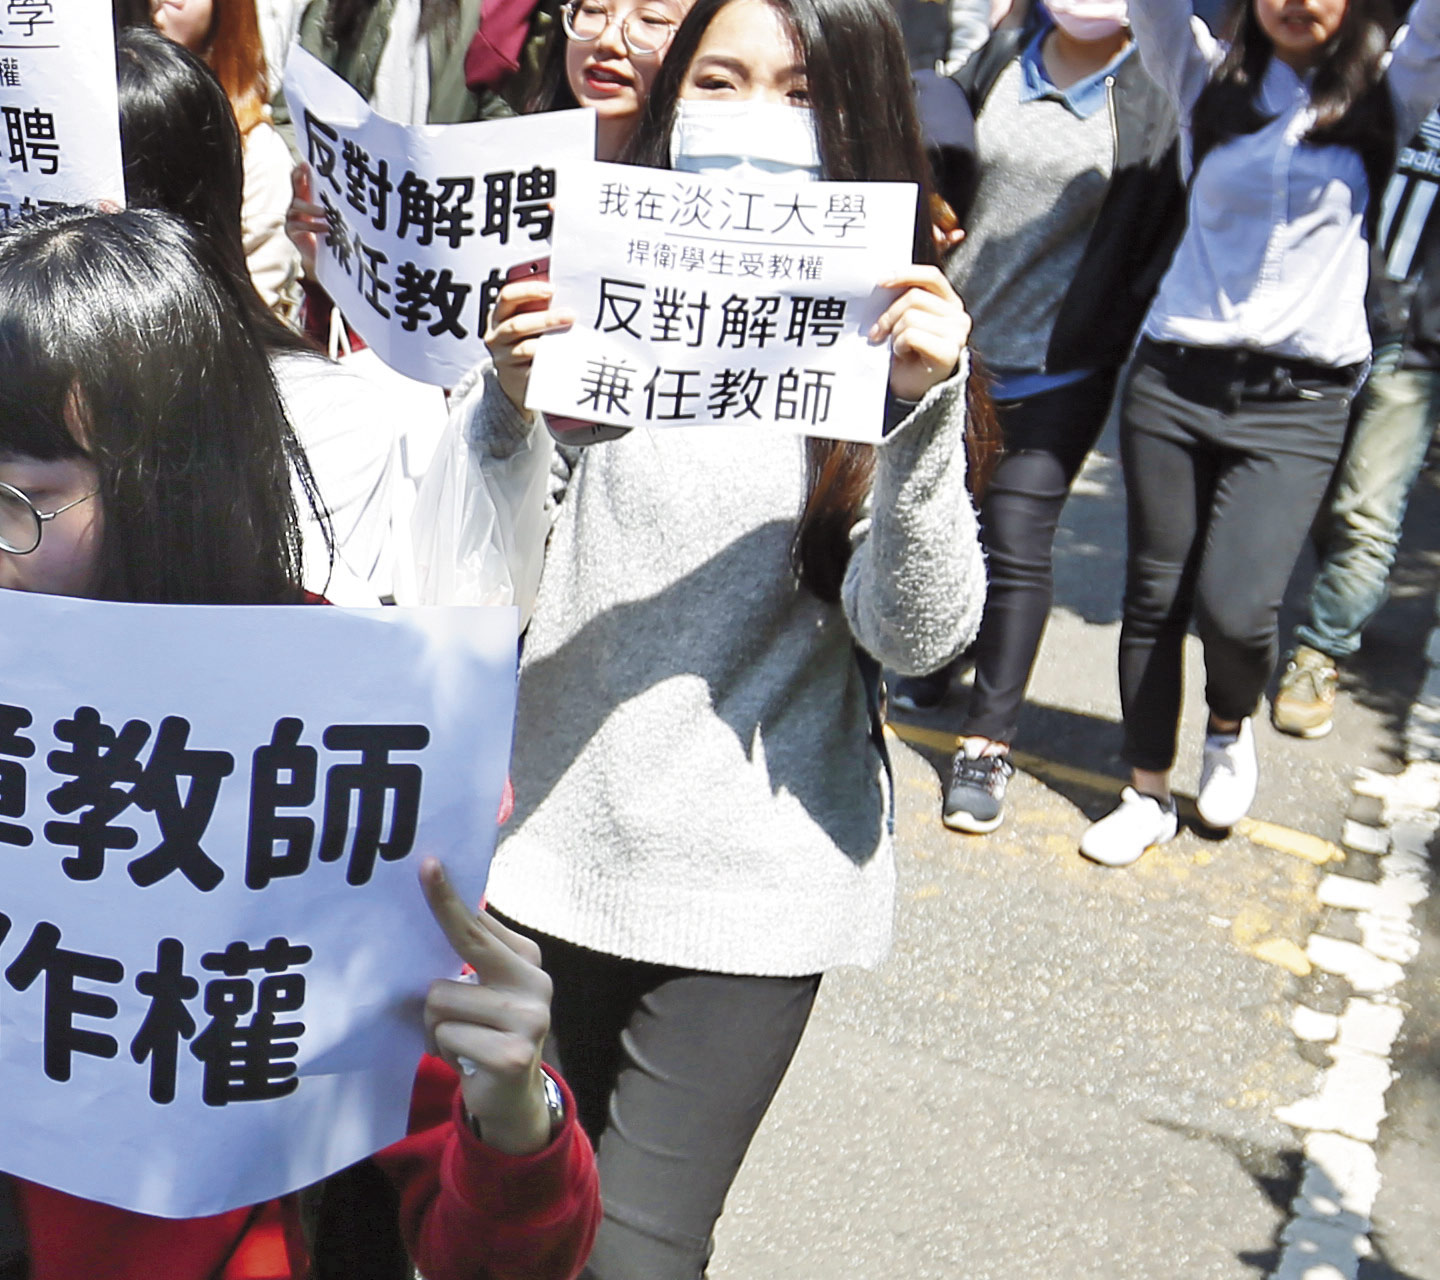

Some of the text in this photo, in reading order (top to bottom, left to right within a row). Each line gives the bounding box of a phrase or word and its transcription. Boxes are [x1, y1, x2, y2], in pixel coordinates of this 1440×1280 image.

[304, 108, 556, 250] 反對解聘
[598, 182, 866, 238] 我在淡江大學
[627, 239, 824, 281] 捍衛學生受教權
[593, 276, 847, 349] 反對解聘
[576, 355, 836, 427] 兼任教師
